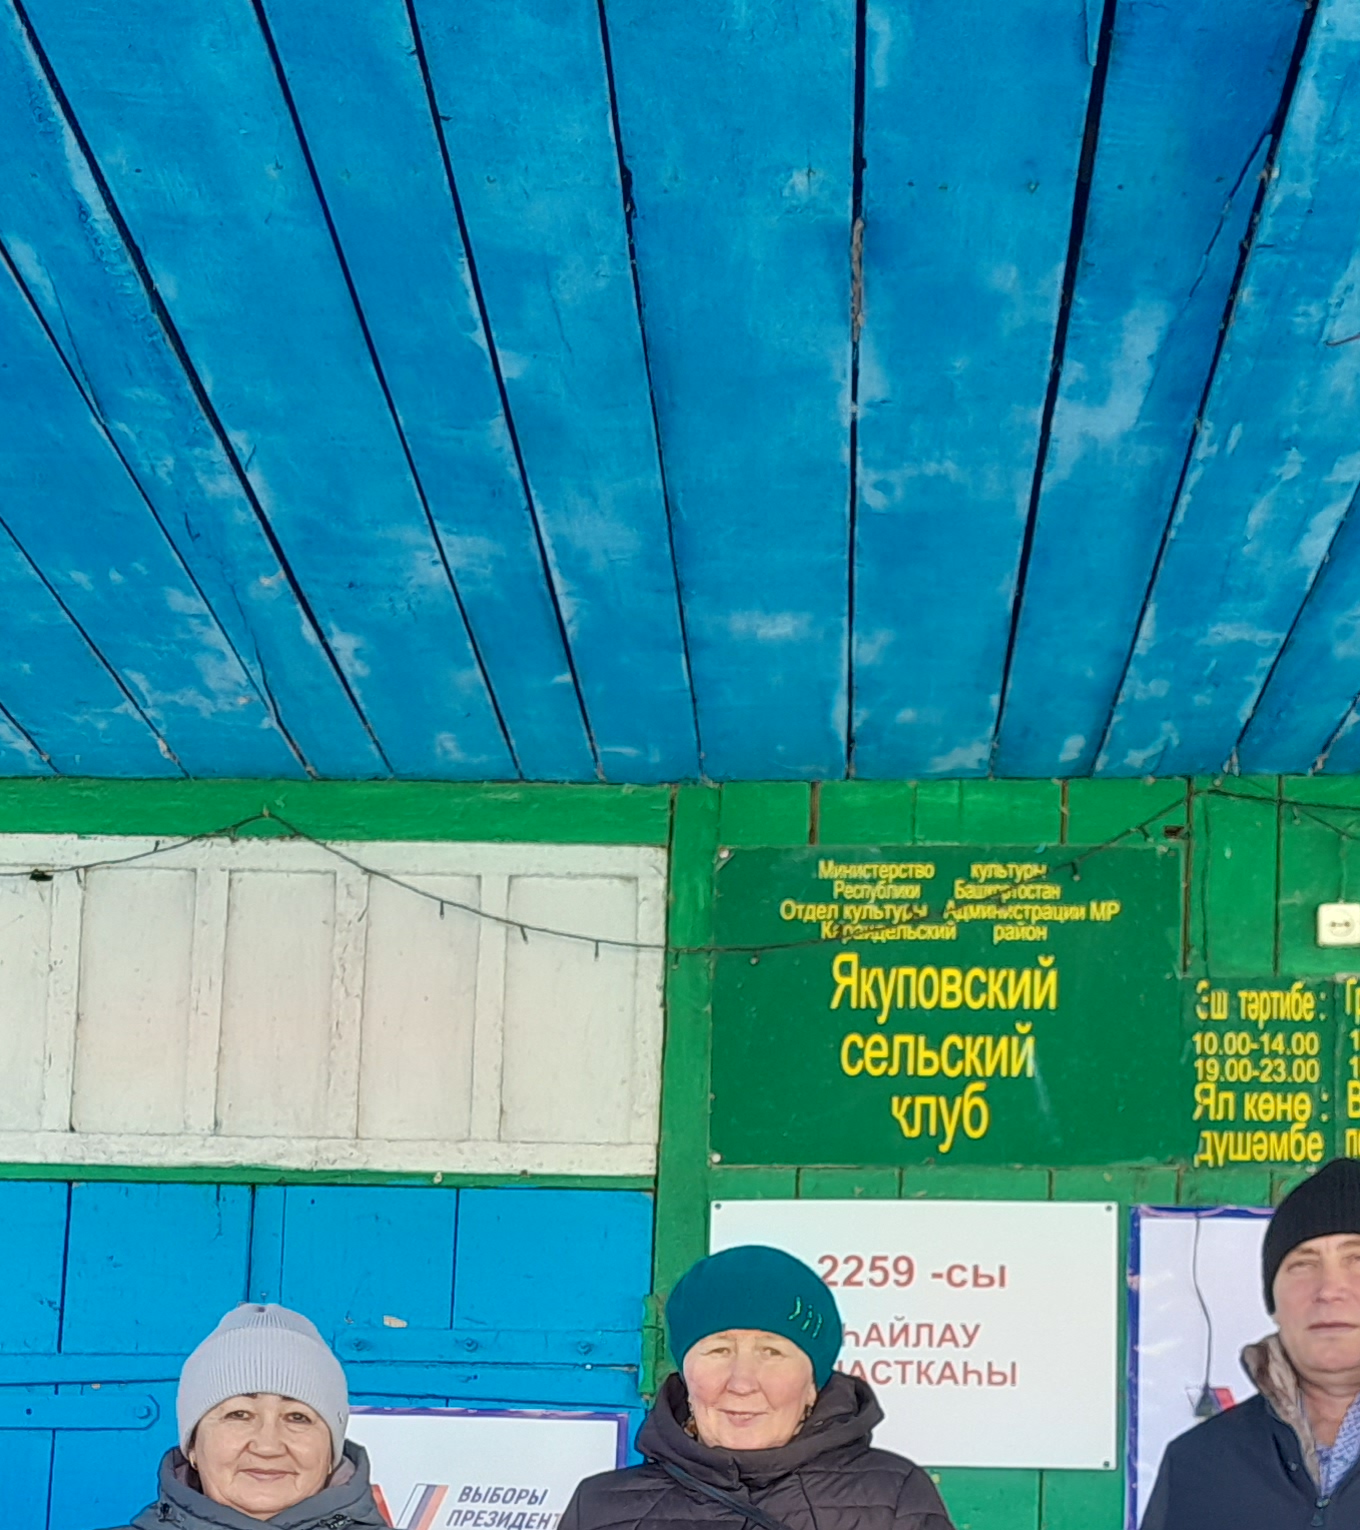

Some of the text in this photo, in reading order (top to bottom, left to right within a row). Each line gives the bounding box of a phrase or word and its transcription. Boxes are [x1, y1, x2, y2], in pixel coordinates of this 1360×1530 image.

[818, 860, 1047, 883] Министерство культуры
[833, 879, 921, 904] Республики
[779, 900, 839, 923] Отдел
[842, 904, 928, 925] культуры
[1090, 902, 1121, 921] МР
[830, 952, 1058, 1024] Якуповский
[840, 1021, 1036, 1077] сельский
[1192, 1031, 1320, 1056] 10.00-14.00
[1193, 1057, 1320, 1083] 19.00-23.00
[1192, 1082, 1236, 1121] Ял
[891, 1081, 990, 1153] клуб
[817, 1254, 915, 1287] 2259
[457, 1485, 549, 1507] ВЫБОРЫ
